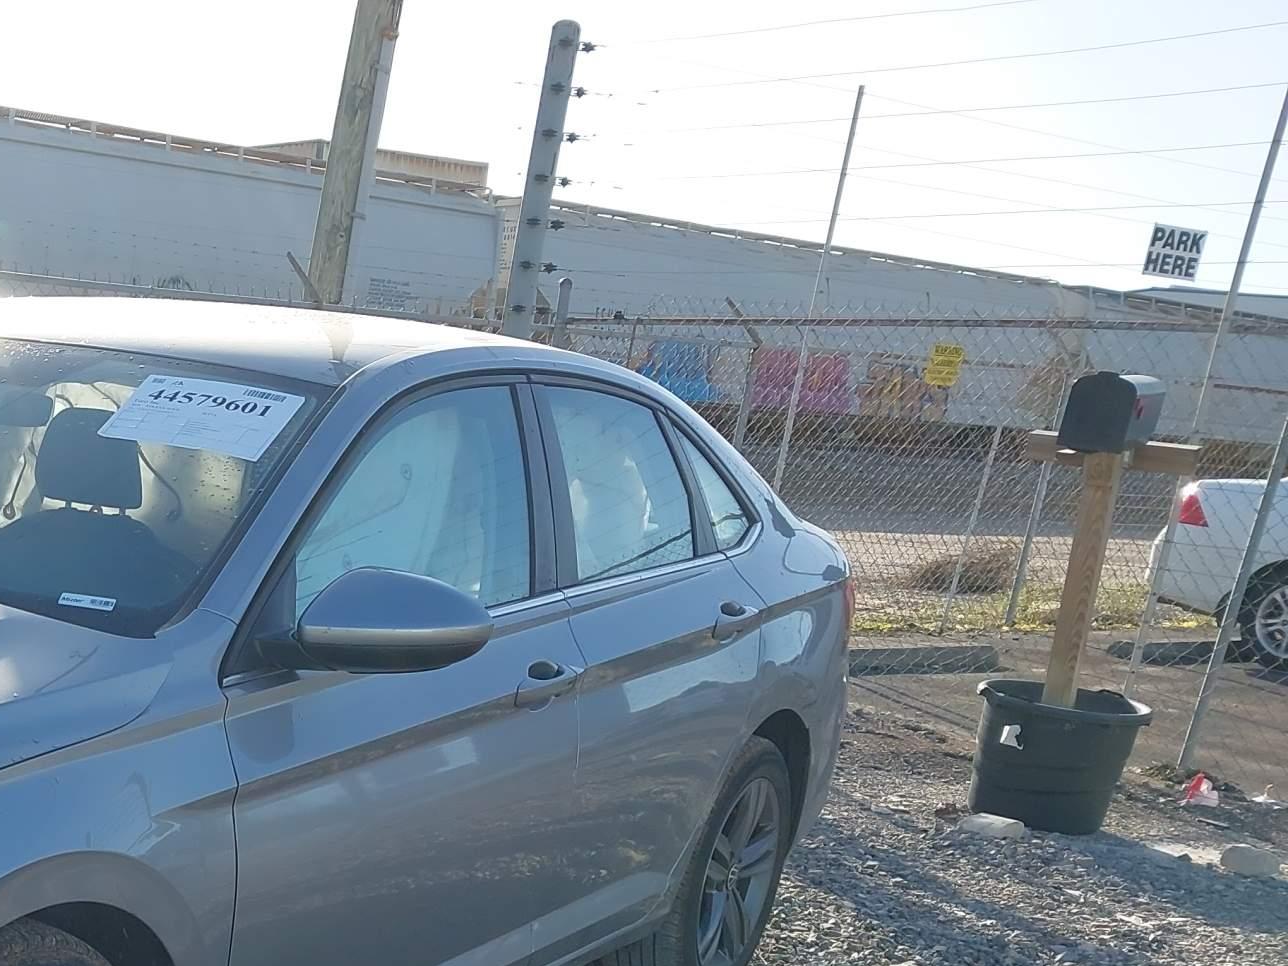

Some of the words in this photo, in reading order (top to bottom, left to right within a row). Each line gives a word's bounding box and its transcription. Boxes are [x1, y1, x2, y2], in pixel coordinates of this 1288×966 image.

[1151, 227, 1207, 254] PARK
[1144, 251, 1198, 277] HERE
[148, 388, 272, 417] 44579601
